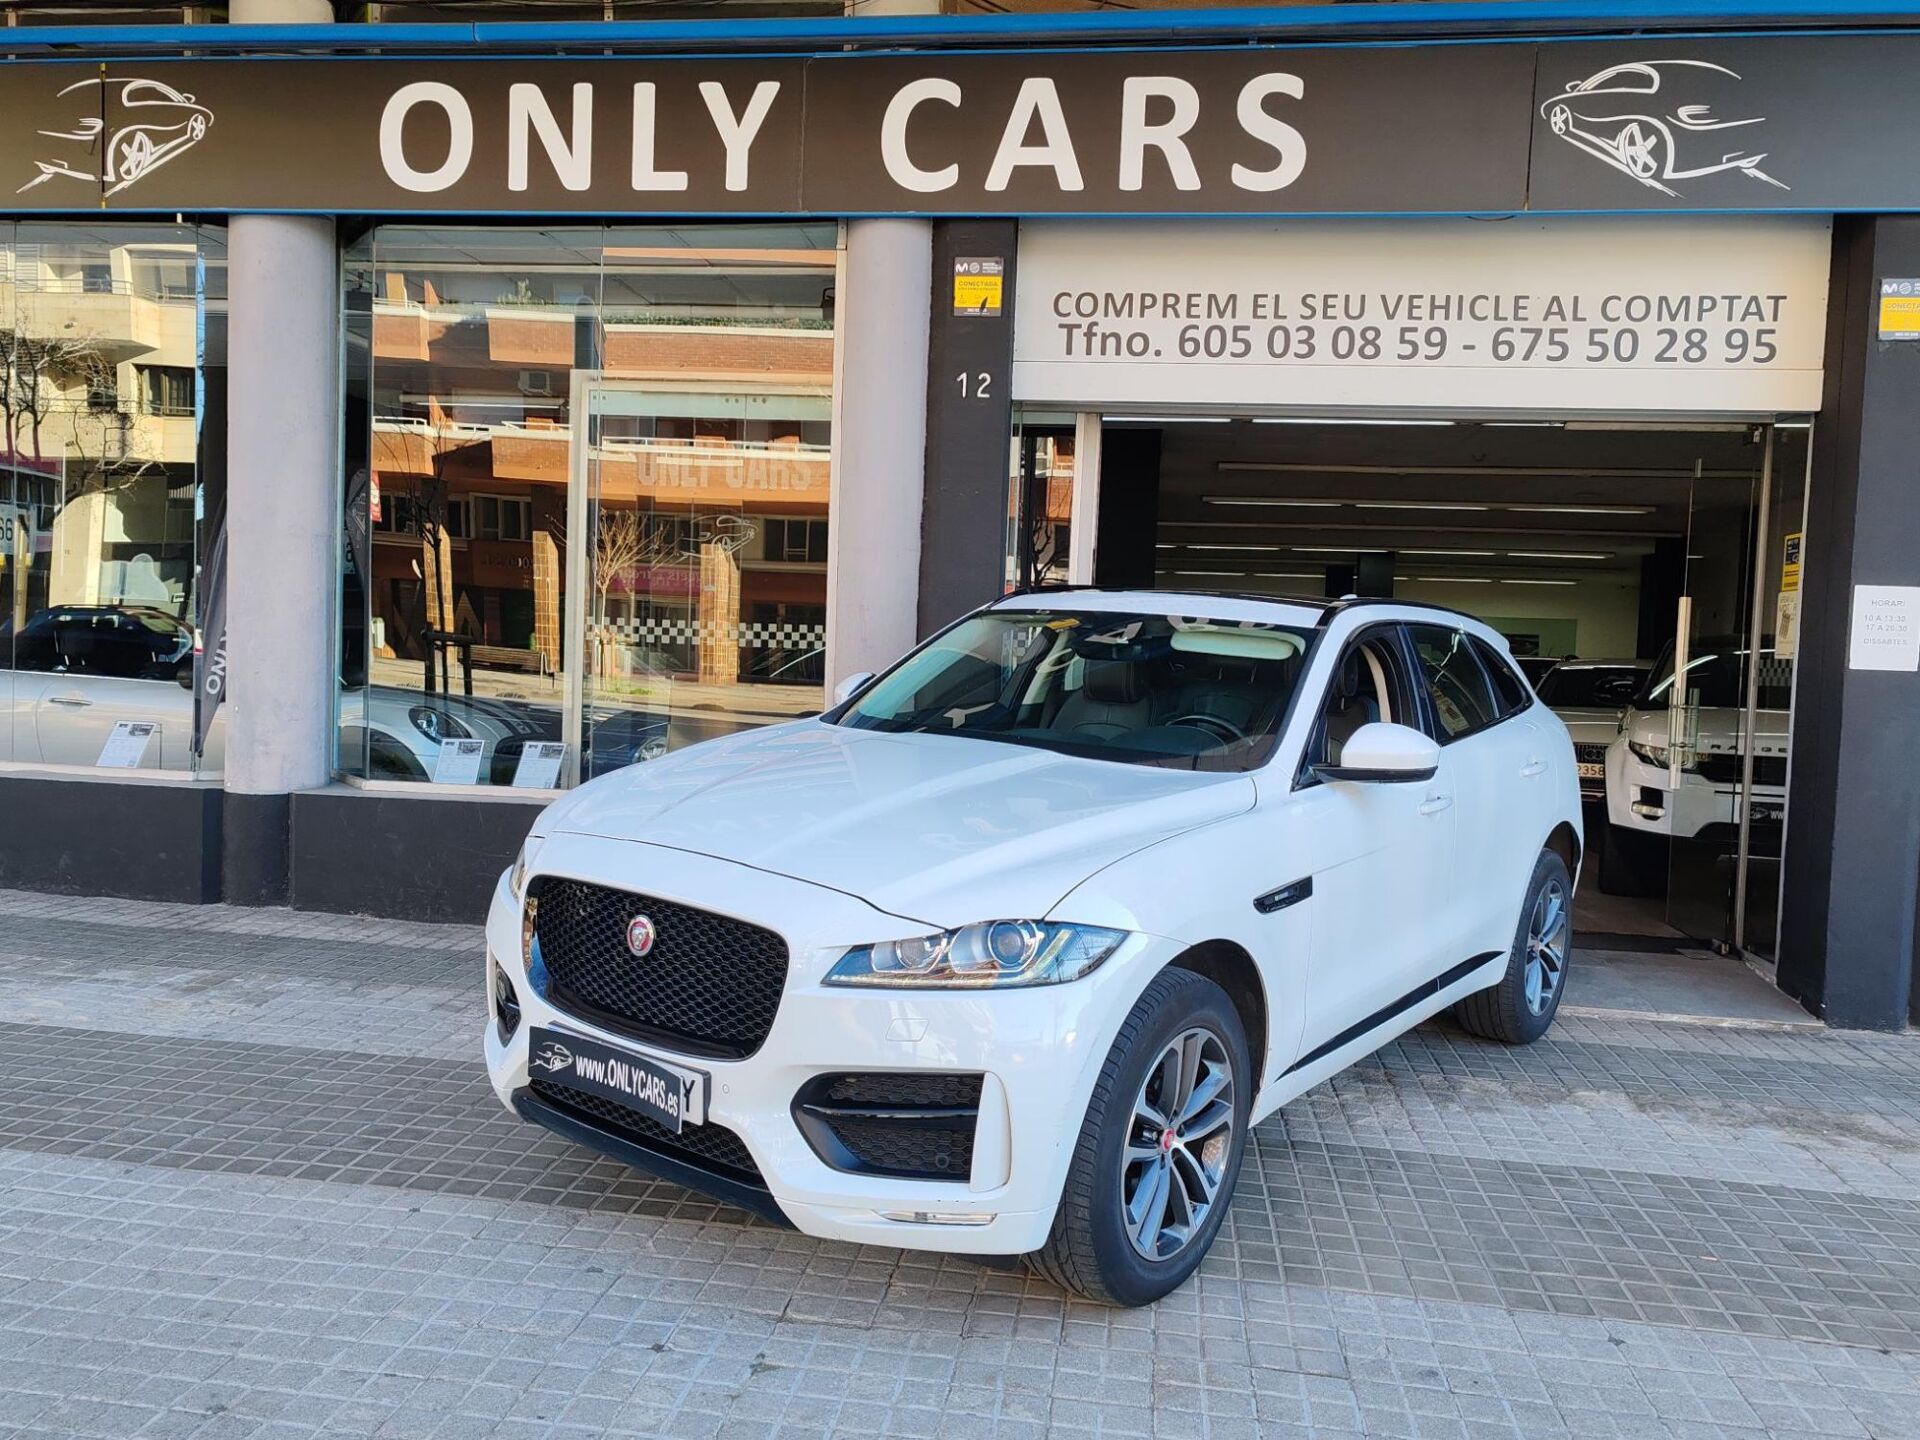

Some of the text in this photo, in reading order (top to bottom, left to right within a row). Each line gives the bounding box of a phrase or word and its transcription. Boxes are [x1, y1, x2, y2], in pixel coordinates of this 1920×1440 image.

[379, 73, 1307, 193] ONLY CARS
[1053, 291, 1788, 323] COMPREM EL SEU VEHICLE AL COMPTAT
[1057, 320, 1163, 357] Tfno.
[1178, 324, 1252, 359] 605
[1266, 324, 1316, 360] 03
[1331, 325, 1382, 360] 08
[1397, 326, 1448, 361] 59
[1491, 326, 1570, 362] 675
[1585, 328, 1639, 363] 50
[1654, 328, 1708, 363] 28
[1724, 328, 1777, 364] 95
[1864, 614, 1874, 622] 10
[1871, 599, 1906, 607] HORARI
[575, 1054, 679, 1117] www.ONLYCARS.es
